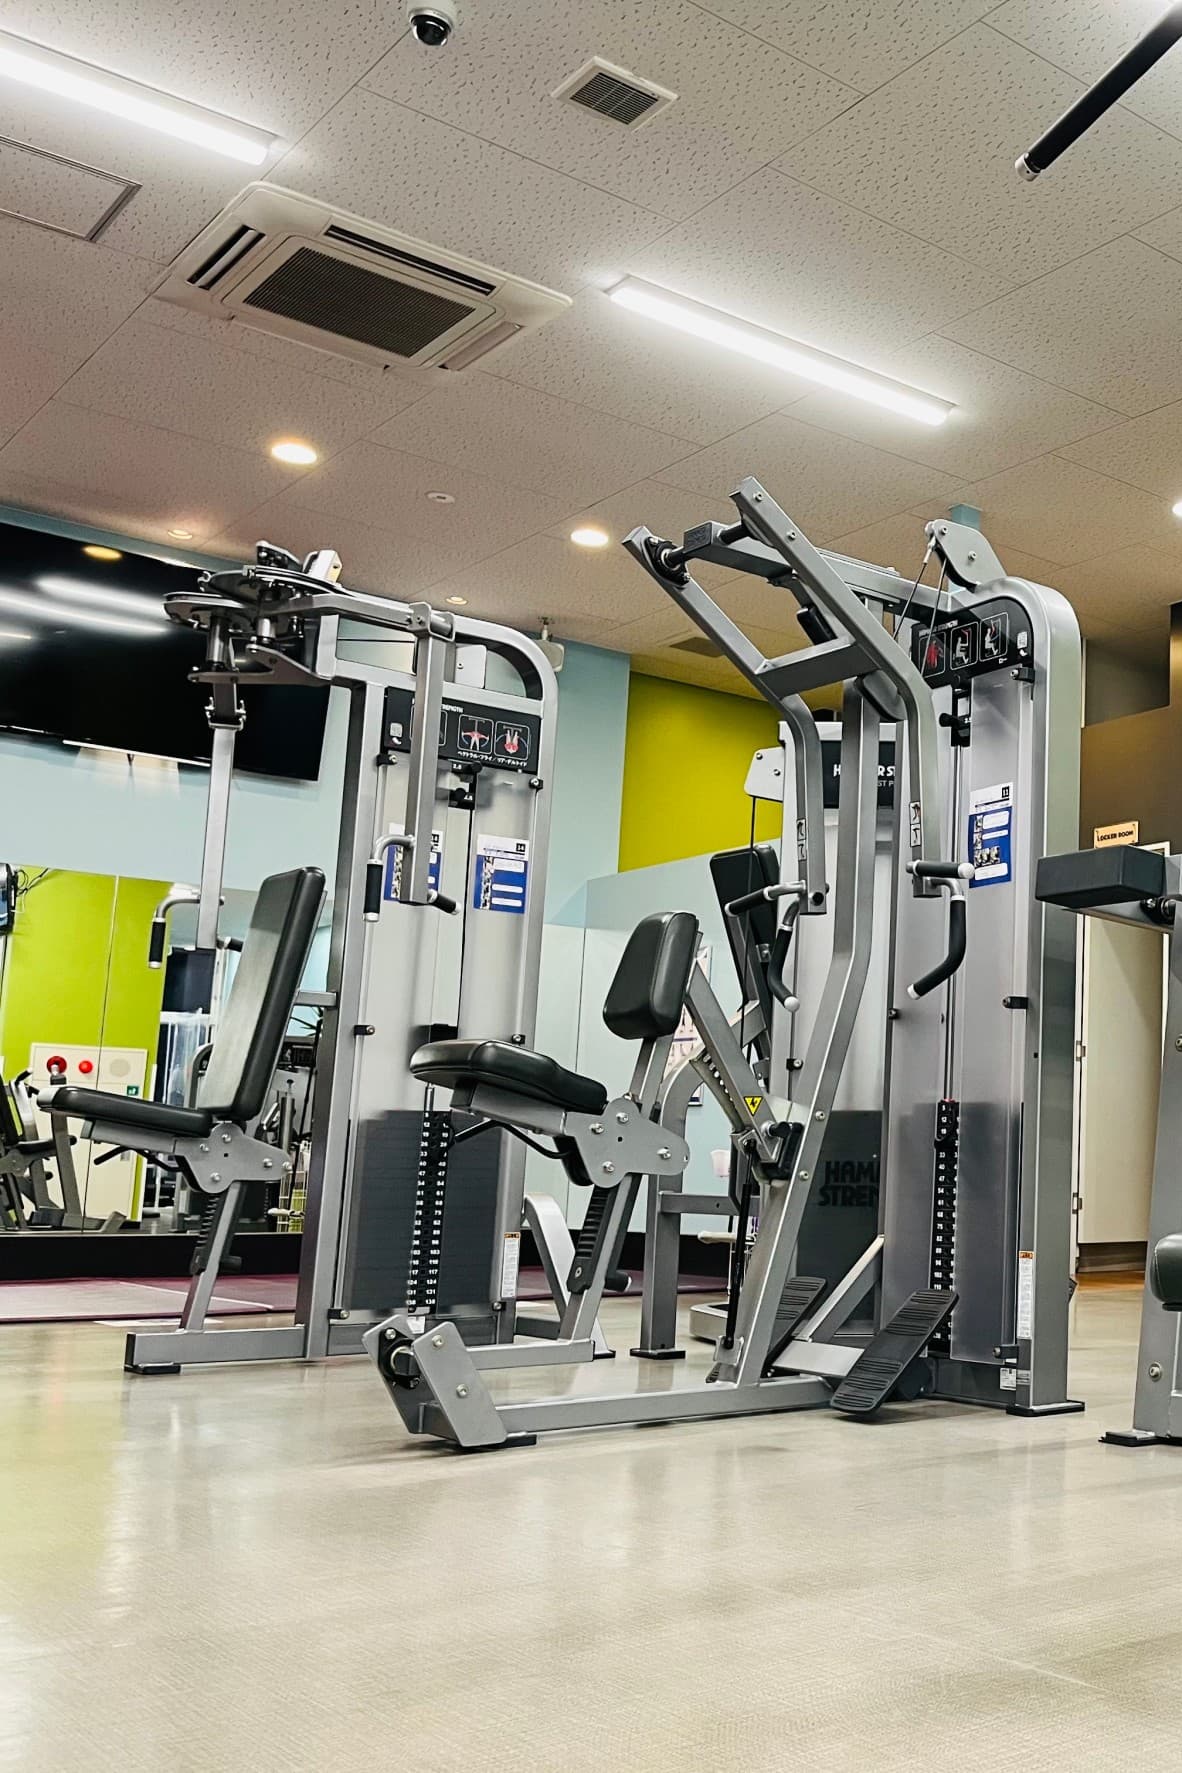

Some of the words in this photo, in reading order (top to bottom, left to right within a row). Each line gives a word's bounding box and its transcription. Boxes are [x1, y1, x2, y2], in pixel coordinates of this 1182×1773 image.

[1097, 833, 1117, 842] LOCKER
[1118, 830, 1134, 838] ROOM
[825, 1161, 880, 1185] HAM
